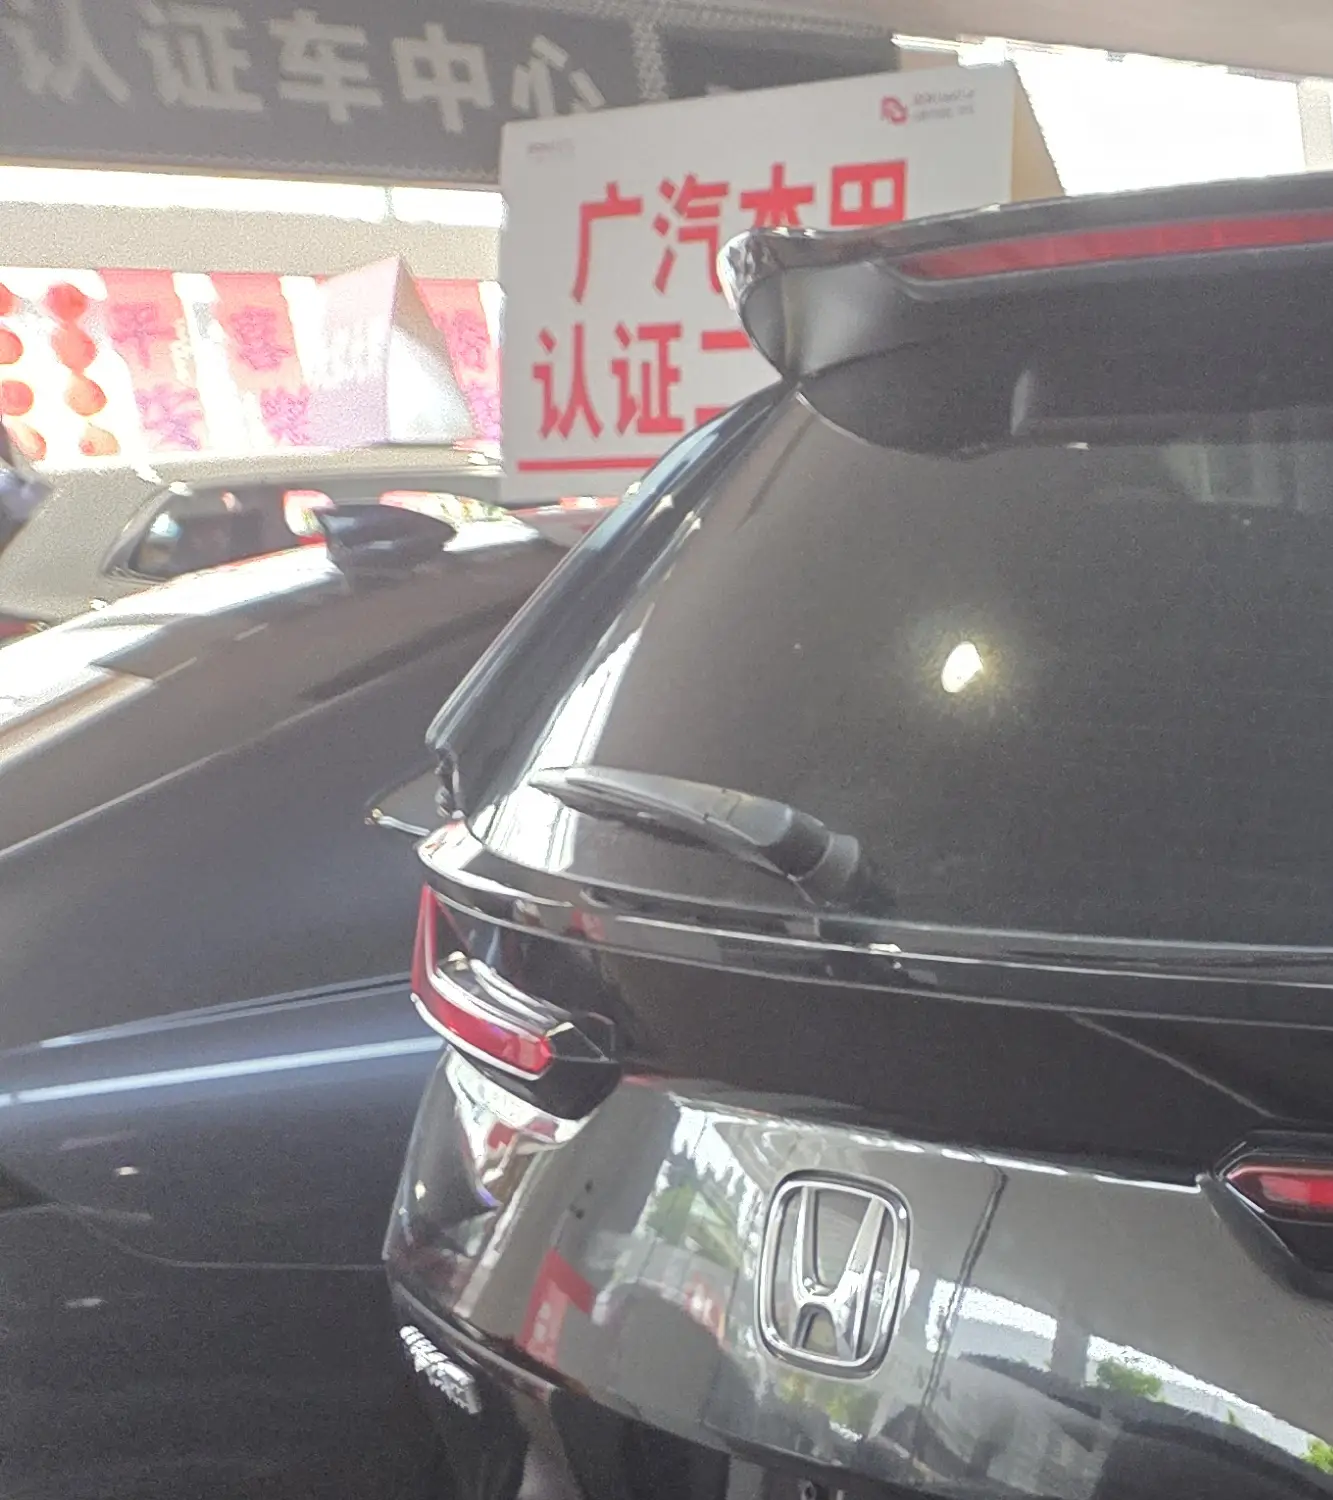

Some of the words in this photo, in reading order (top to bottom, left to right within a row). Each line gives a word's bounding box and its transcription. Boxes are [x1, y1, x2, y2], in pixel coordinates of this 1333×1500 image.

[2, 0, 608, 133] 认证车中心
